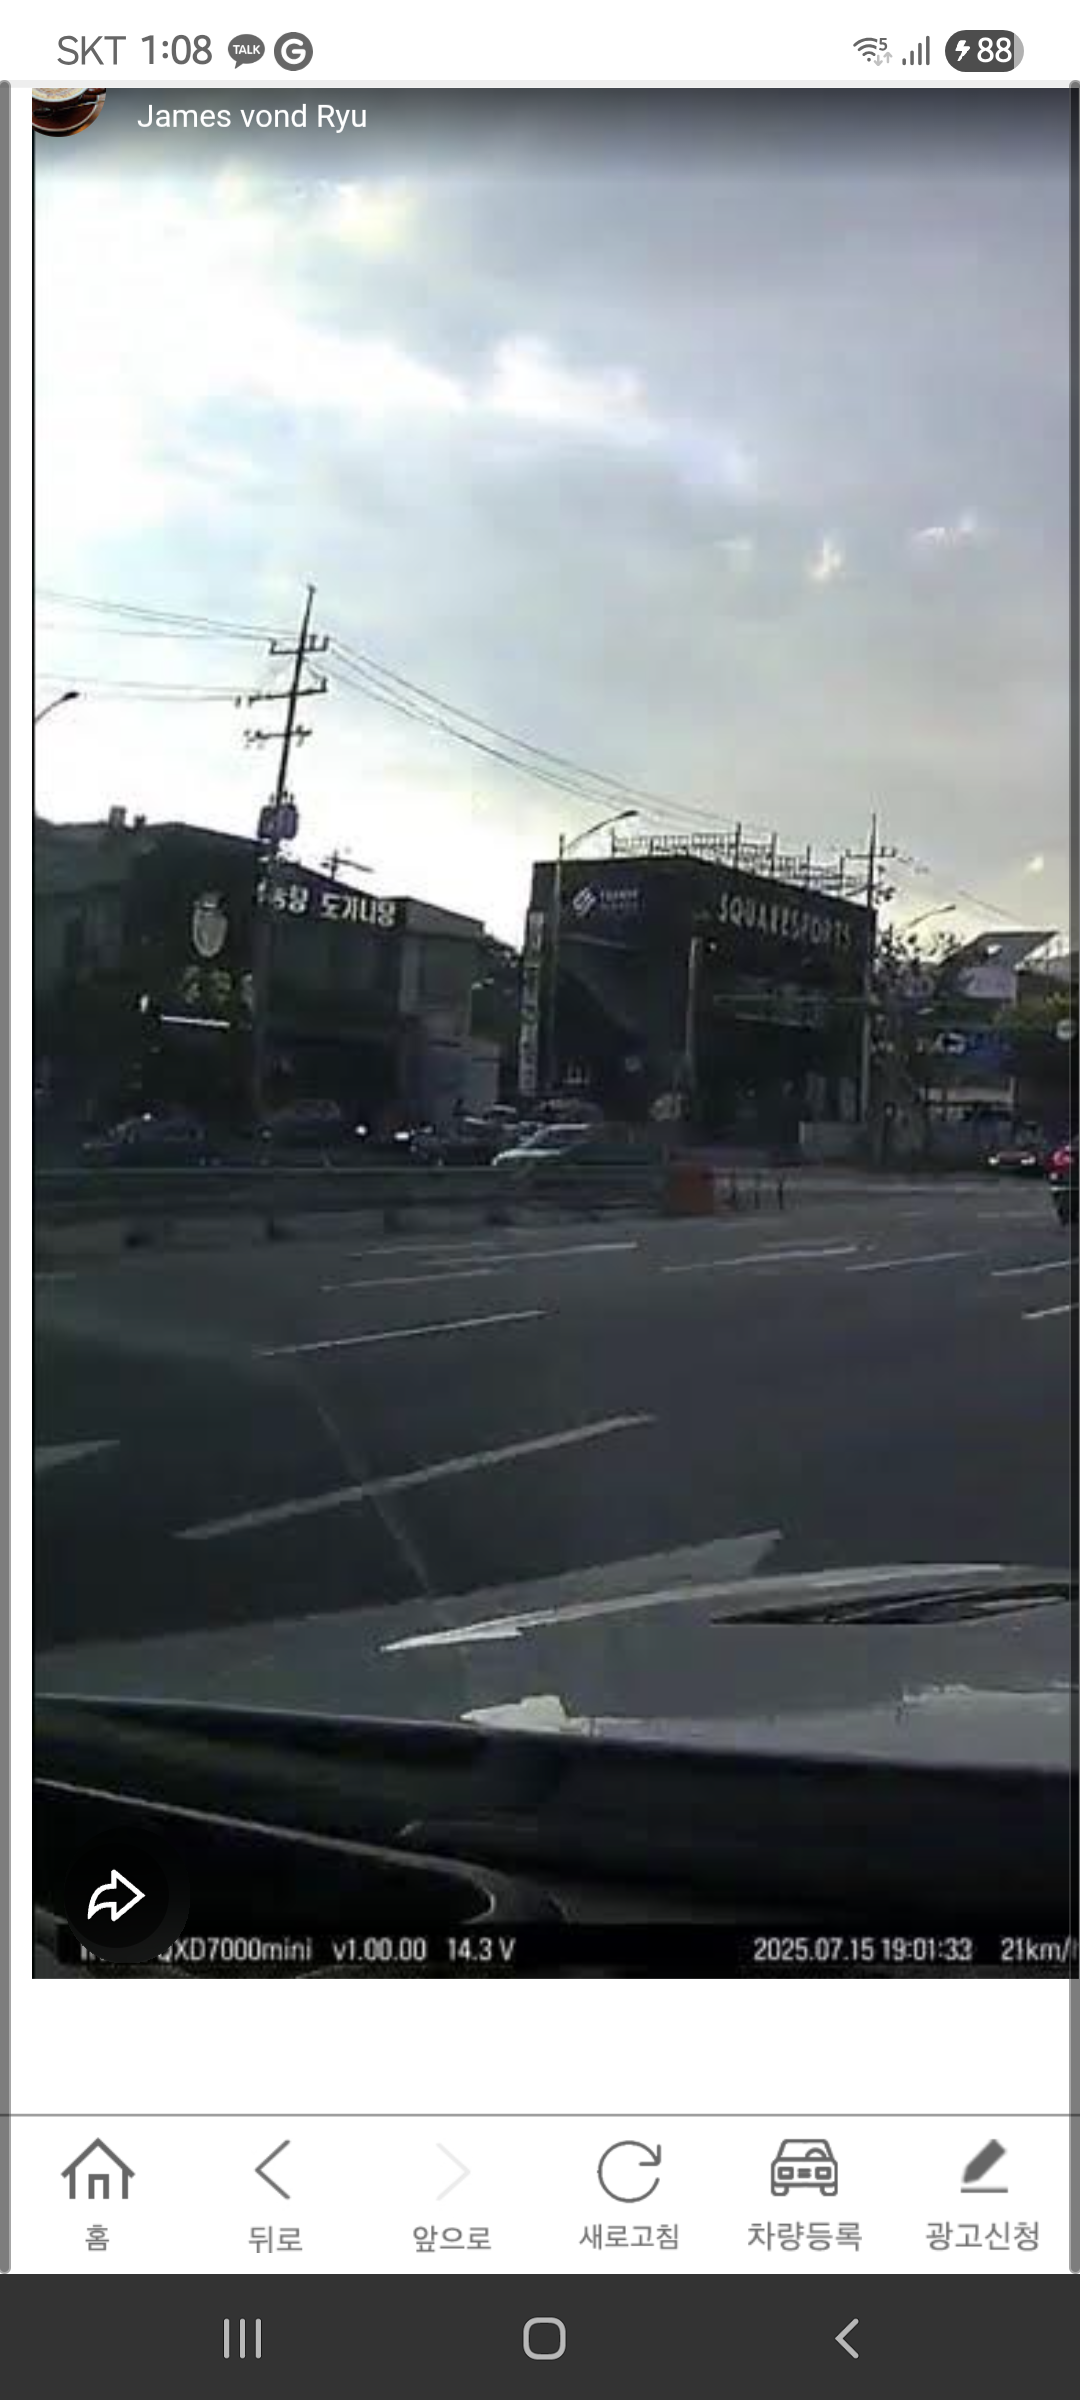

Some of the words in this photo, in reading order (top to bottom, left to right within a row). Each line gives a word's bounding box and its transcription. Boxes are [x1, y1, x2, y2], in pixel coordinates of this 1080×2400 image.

[58, 35, 126, 66] SKT
[141, 34, 213, 65] 1:08
[232, 44, 261, 55] TALK
[878, 37, 888, 52] 5
[976, 36, 1013, 63] 88
[85, 2224, 110, 2251] 홈
[248, 2225, 303, 2254] 뒤로
[413, 2225, 492, 2253] 앞으로
[579, 2223, 678, 2250] 새로고침
[747, 2221, 862, 2252] 차량등록
[926, 2221, 1039, 2251] 광고신청
